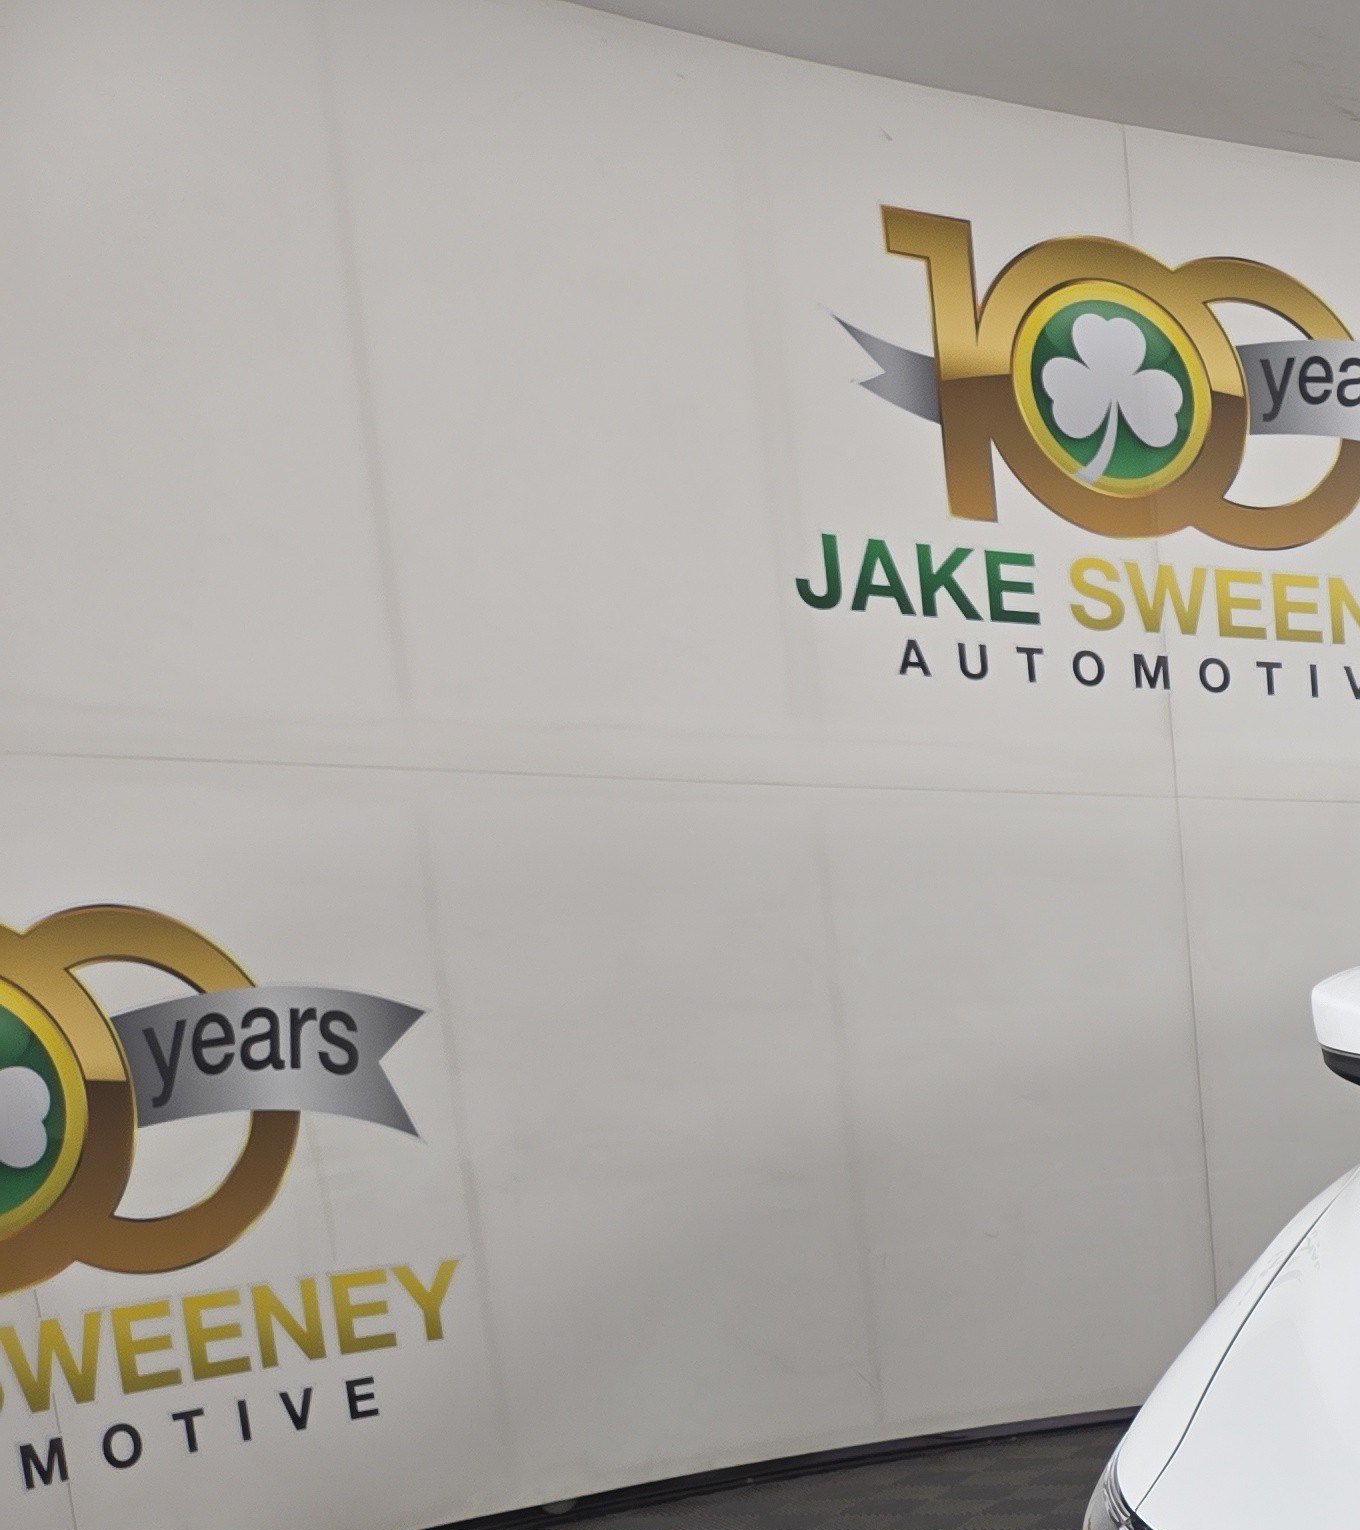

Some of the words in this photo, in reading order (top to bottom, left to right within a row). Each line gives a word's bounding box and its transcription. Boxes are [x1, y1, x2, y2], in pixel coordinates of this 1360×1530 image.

[795, 532, 1042, 625] JAKE
[142, 1006, 360, 1108] years
[0, 1259, 460, 1414] WEENEY
[19, 1376, 379, 1490] MOTIVE
